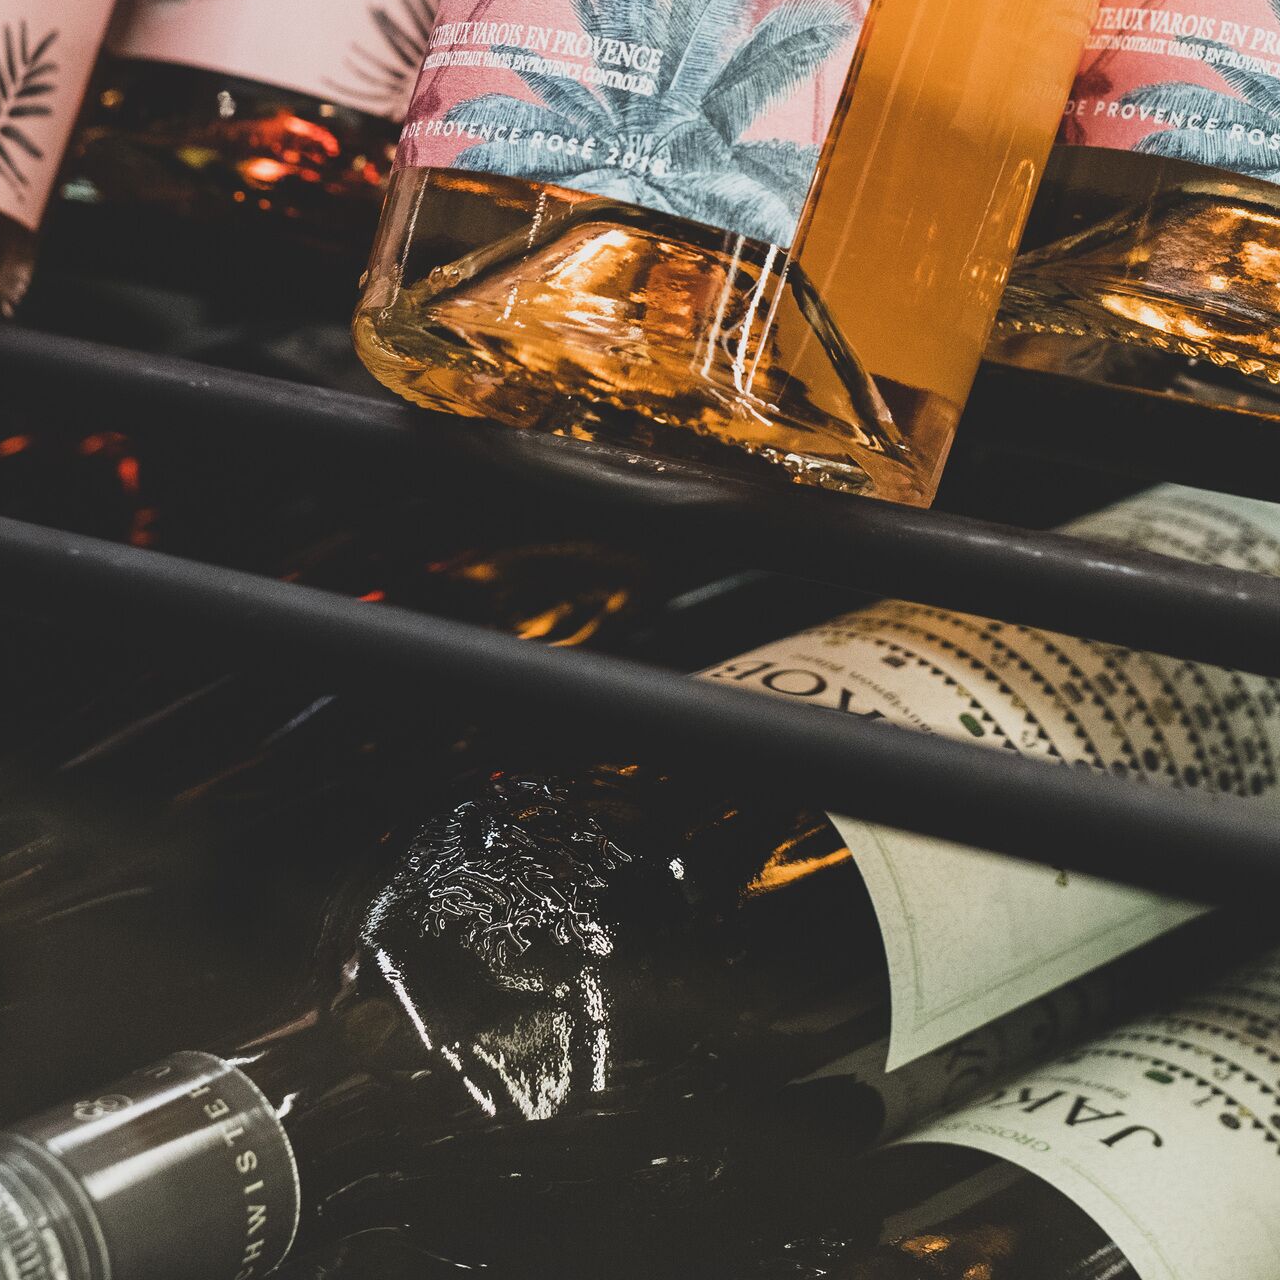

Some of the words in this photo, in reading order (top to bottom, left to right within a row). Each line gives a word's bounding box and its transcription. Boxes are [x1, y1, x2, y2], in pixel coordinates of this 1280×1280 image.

[1147, 10, 1216, 43] VAROIS
[1219, 20, 1249, 45] EN
[471, 20, 521, 48] VAROIS
[524, 25, 554, 52] EN
[552, 30, 664, 74] PROVENCE
[1093, 101, 1220, 134] PROVENCE
[424, 120, 521, 144] PROVENCE
[530, 130, 598, 160] ROSÉ
